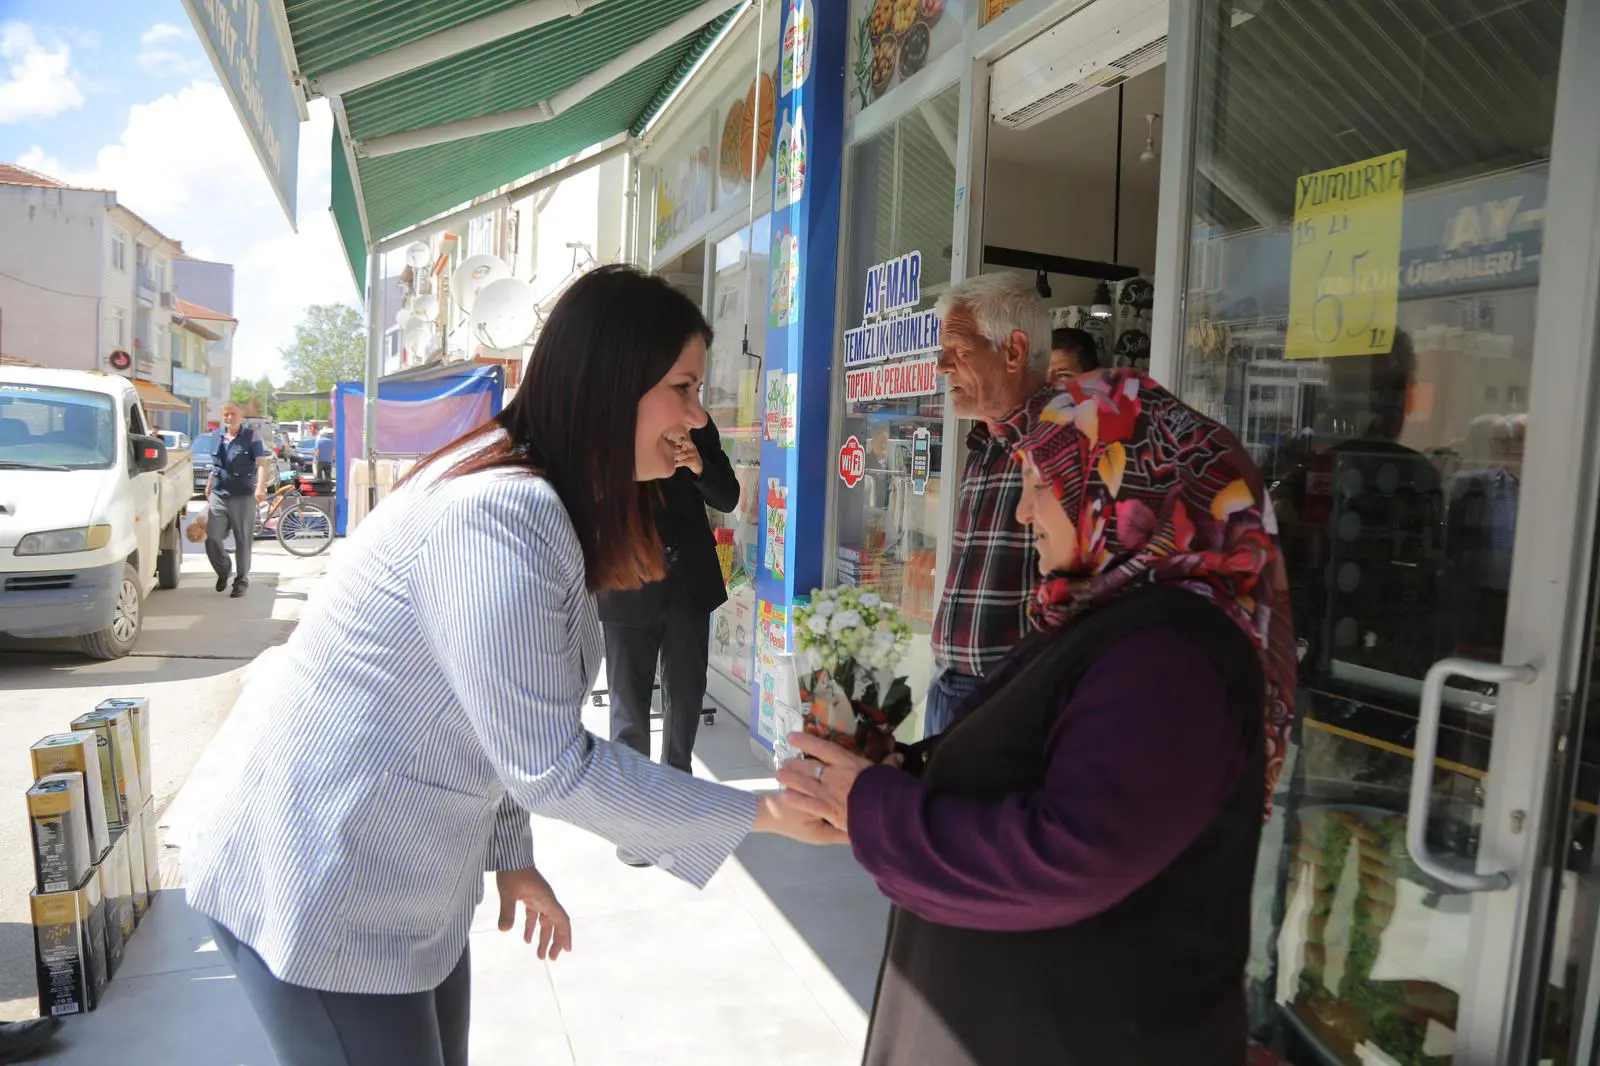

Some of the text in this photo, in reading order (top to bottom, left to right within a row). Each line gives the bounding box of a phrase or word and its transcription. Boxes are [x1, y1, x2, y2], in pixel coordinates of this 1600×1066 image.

[1298, 157, 1405, 210] YUMURTA
[864, 253, 921, 317] AY-MAR
[844, 318, 887, 364] TEMİZLİK
[846, 361, 936, 399] TOPTAN & PERAKENDE
